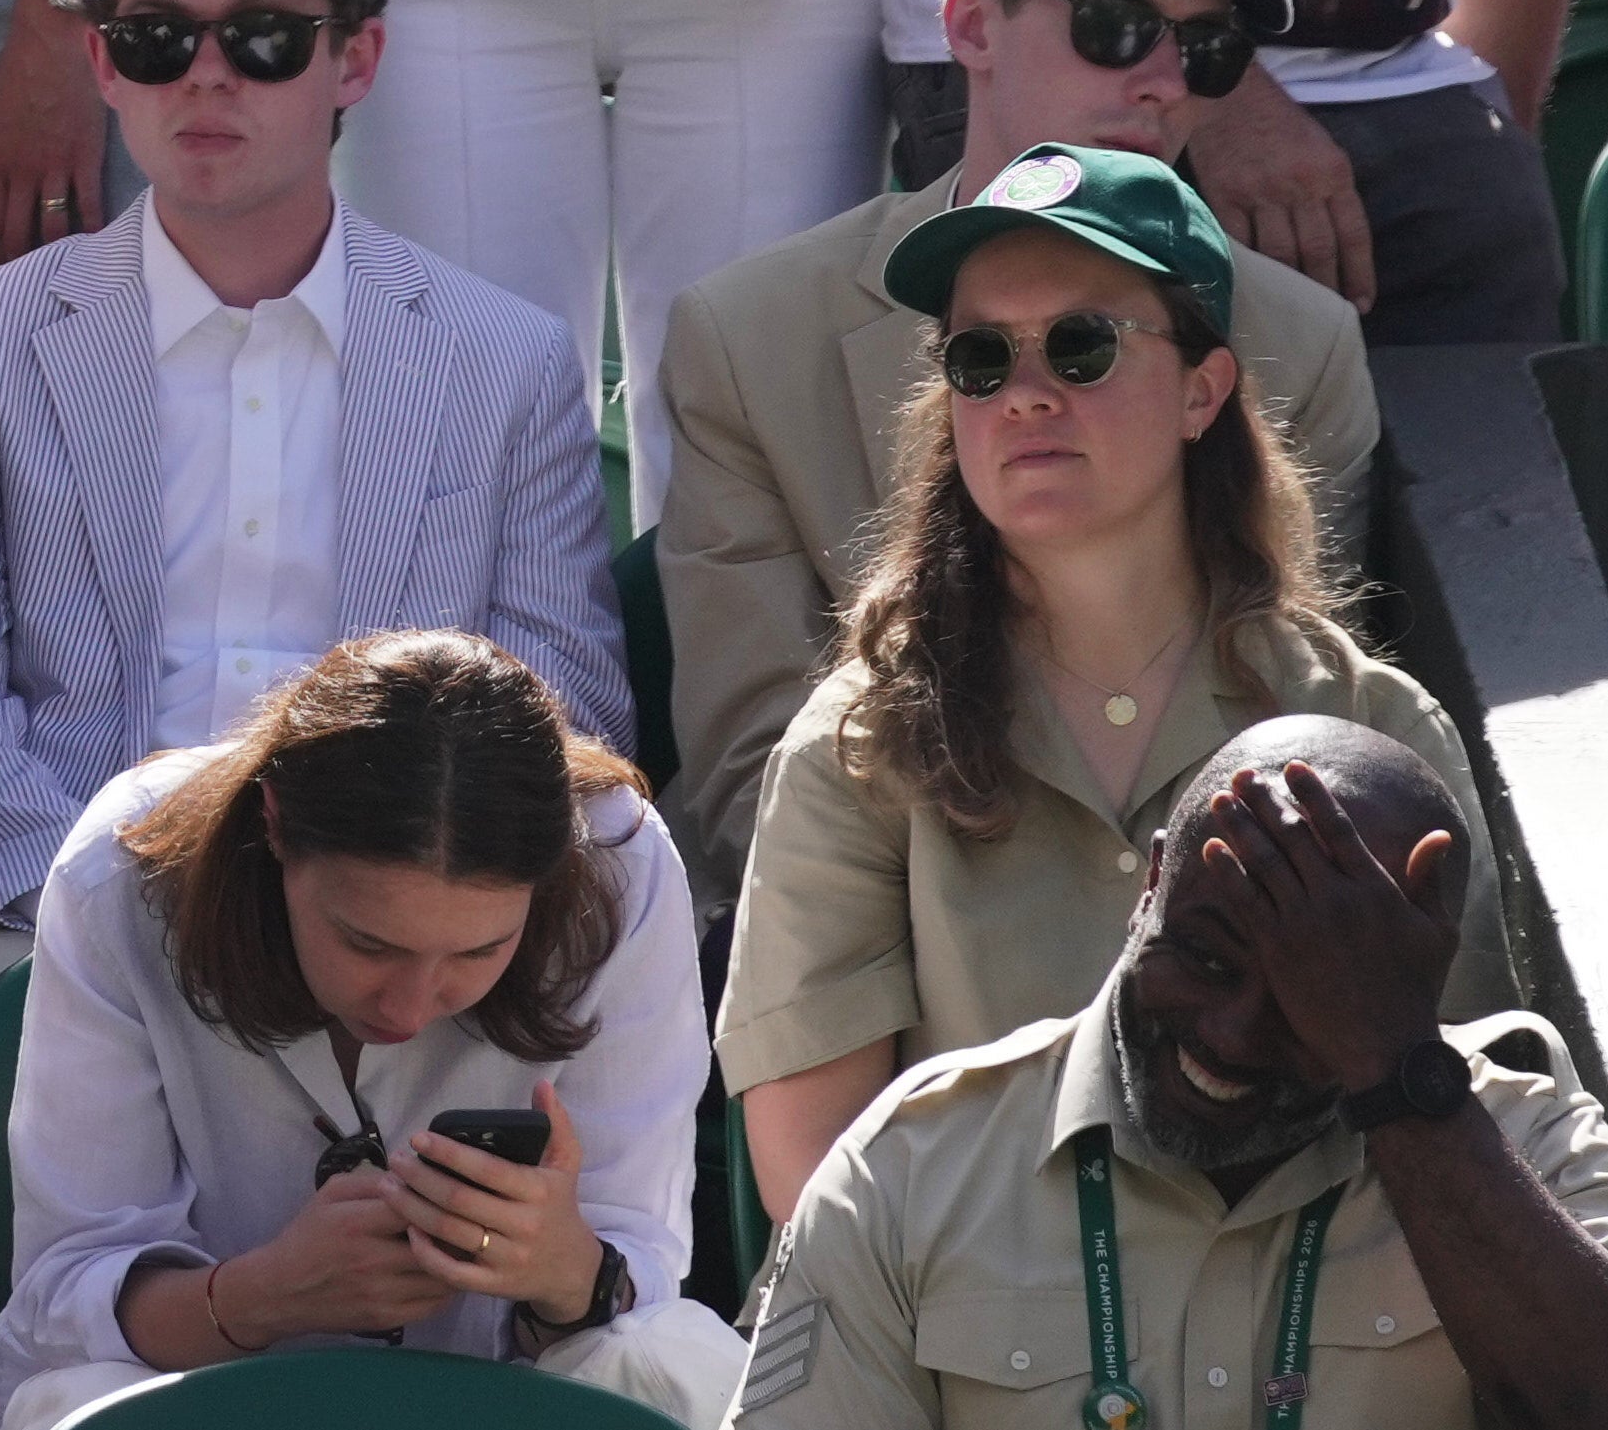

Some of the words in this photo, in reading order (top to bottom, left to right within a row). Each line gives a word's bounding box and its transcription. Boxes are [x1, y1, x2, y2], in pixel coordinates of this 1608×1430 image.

[1093, 1228, 1109, 1259] THE
[1283, 1259, 1310, 1375] HAMPIONSHIPS
[1300, 1219, 1319, 1256] 2026
[1096, 1262, 1119, 1380] CHAMPIONSHIP
